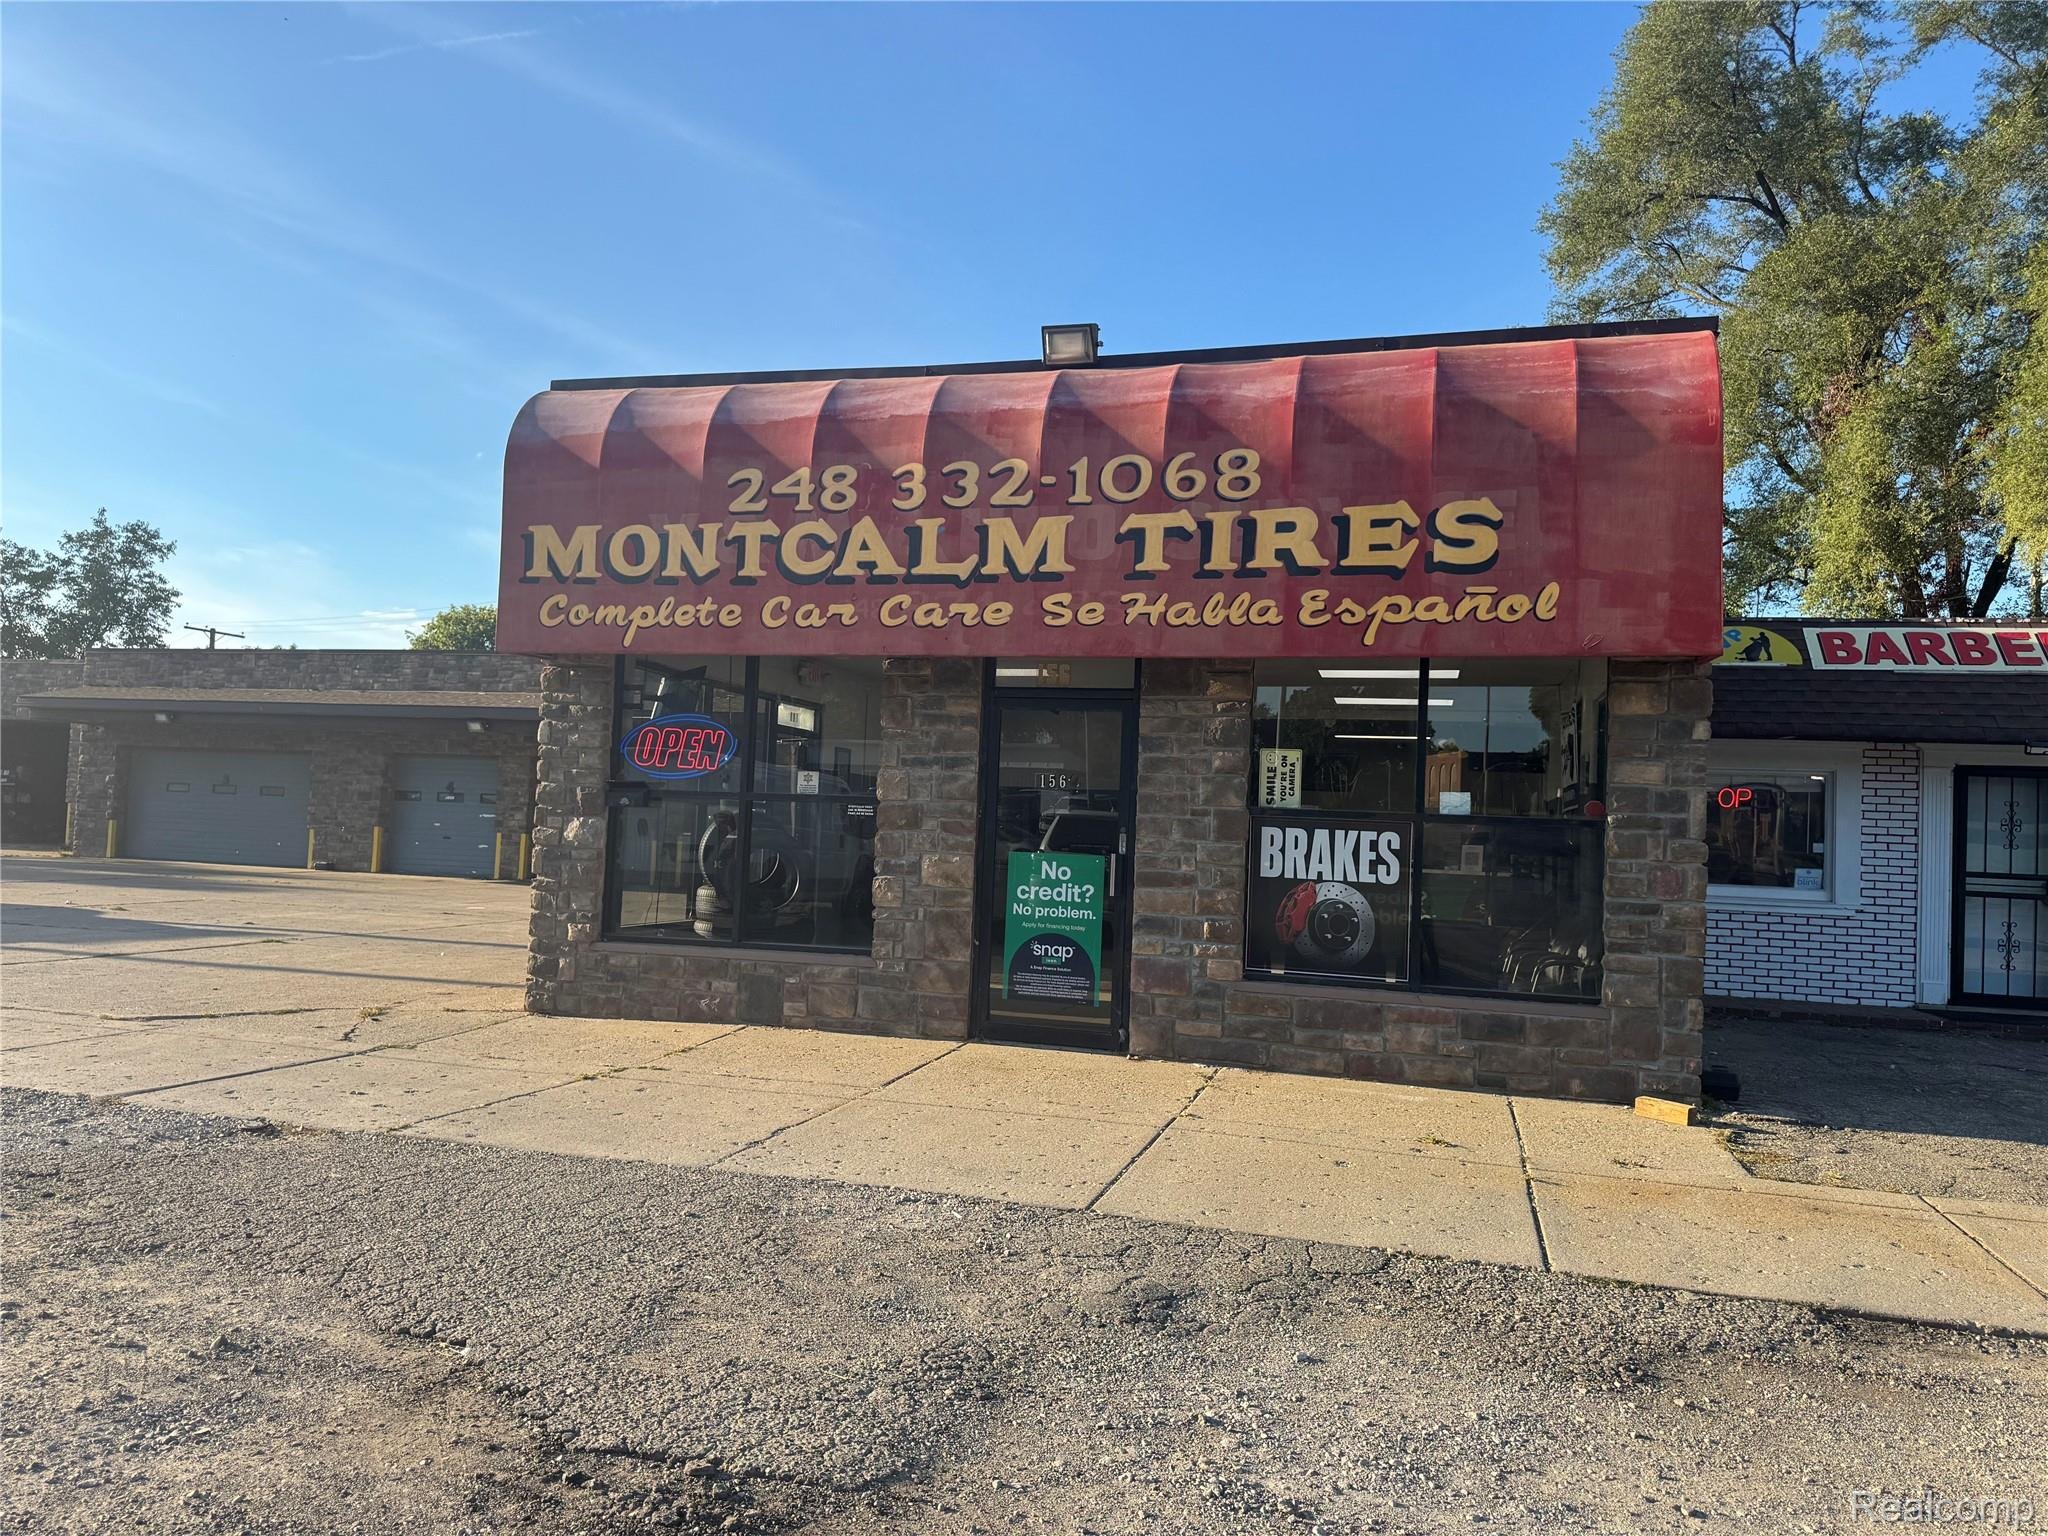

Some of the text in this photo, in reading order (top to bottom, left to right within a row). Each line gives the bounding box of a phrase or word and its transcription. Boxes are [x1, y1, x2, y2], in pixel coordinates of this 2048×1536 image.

[727, 448, 1262, 514] 248 332-1068
[519, 497, 1504, 587] MONTCALM TIRES
[539, 581, 1561, 648] Complete Car Care Se Habla Español
[1816, 631, 2048, 666] BARBE
[634, 726, 726, 772] OPEN
[1040, 774, 1066, 788] 156
[1266, 766, 1277, 805] SMILE
[1280, 755, 1289, 802] YOU'RE ON
[1288, 761, 1296, 797] CAMERA
[1718, 787, 1753, 808] OP
[1041, 861, 1072, 880] No
[1260, 826, 1401, 885] BRAKES
[1016, 883, 1095, 903] credit?
[1013, 903, 1096, 920] No problem.
[1033, 944, 1074, 962] snap
